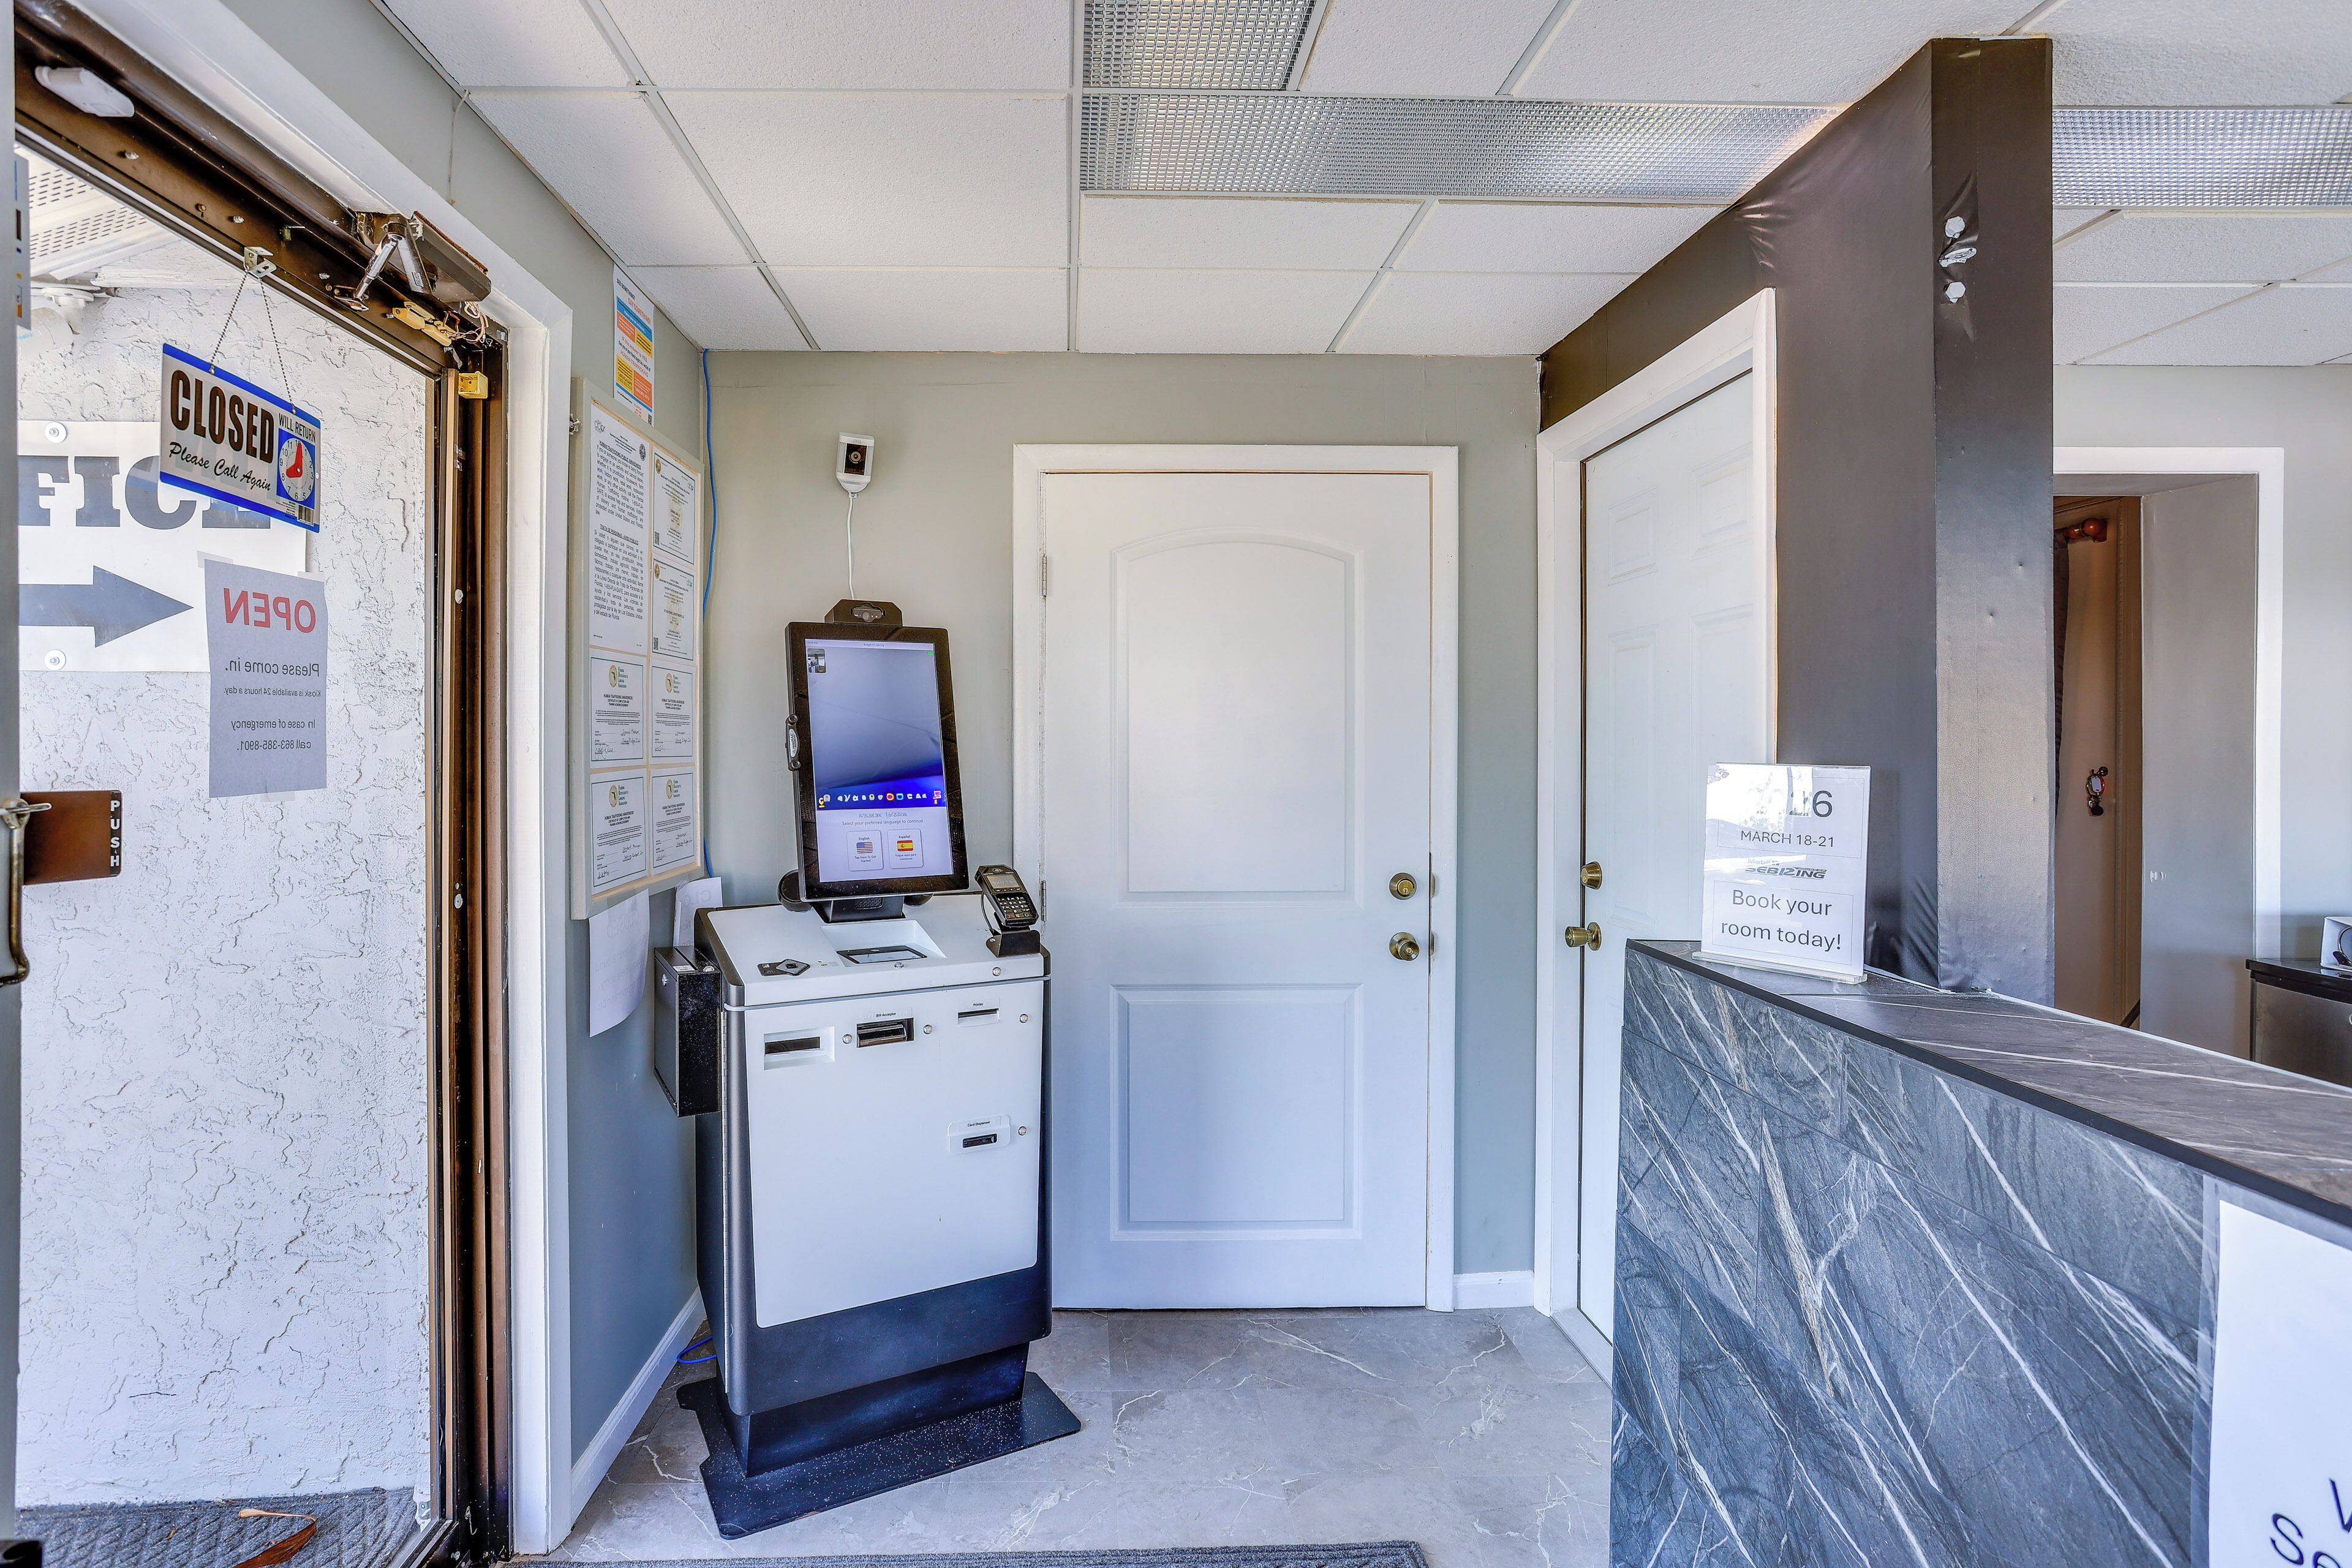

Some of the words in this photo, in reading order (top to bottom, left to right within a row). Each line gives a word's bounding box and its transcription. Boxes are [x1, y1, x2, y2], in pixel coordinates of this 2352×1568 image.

[170, 370, 274, 464] CLOSED
[279, 413, 293, 432] WILL
[295, 421, 316, 443] RETURN
[282, 448, 288, 457] 10
[287, 440, 293, 449] 11
[169, 442, 209, 468] Please
[214, 459, 238, 479] Call
[240, 470, 271, 491] Again
[110, 800, 121, 867] PUSH
[1741, 831, 1792, 844] MARCH
[1796, 834, 1833, 847] 18-21
[1733, 889, 1781, 910] Book
[1786, 899, 1832, 916] your
[1722, 922, 1770, 940] room
[1777, 927, 1841, 952] today!
